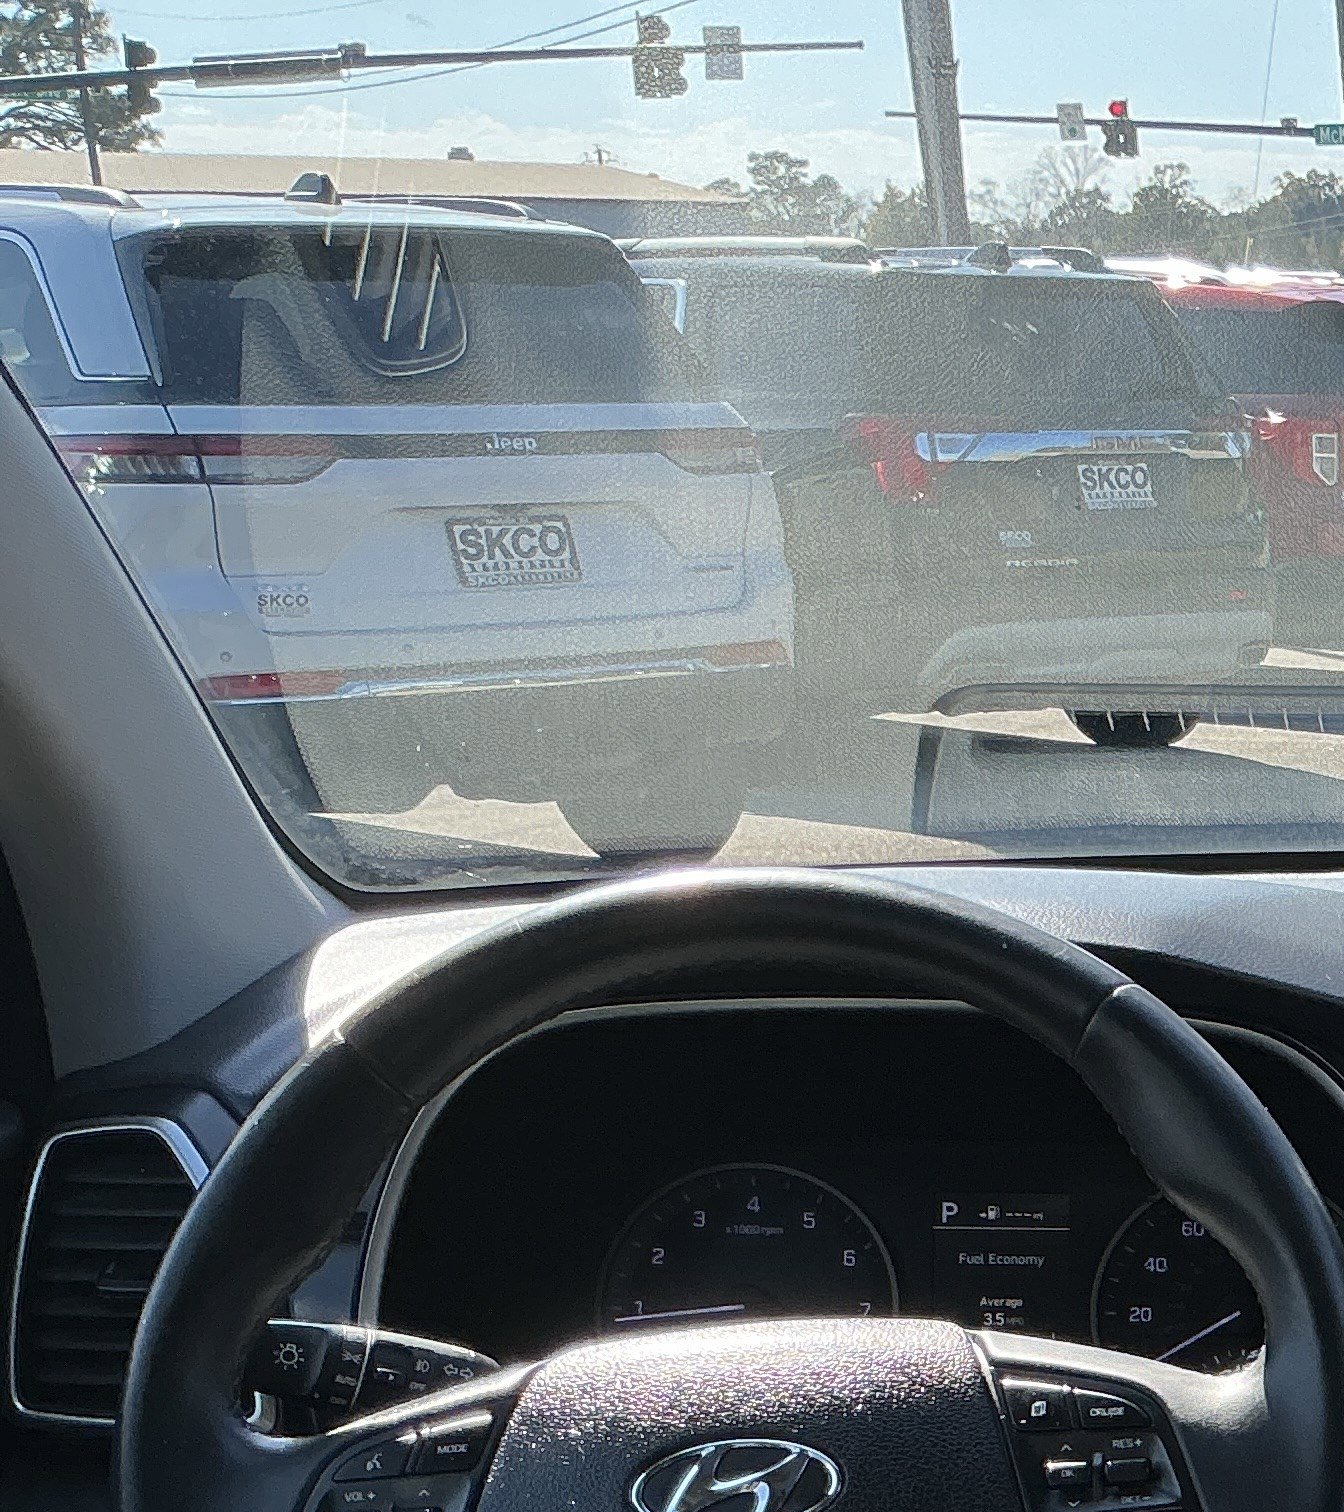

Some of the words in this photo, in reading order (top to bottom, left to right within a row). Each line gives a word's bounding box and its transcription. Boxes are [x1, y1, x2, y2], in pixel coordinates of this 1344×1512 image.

[486, 433, 538, 451] Jeep
[1081, 466, 1151, 492] SKCO
[459, 524, 568, 563] SKCO
[257, 593, 310, 608] SKCO
[747, 1196, 760, 1213] 4
[941, 1201, 958, 1224] P
[692, 1210, 706, 1228] 3
[803, 1212, 816, 1229] 5
[1181, 1221, 1205, 1237] 60
[651, 1247, 665, 1265] 2
[843, 1249, 856, 1267] 6
[958, 1252, 985, 1265] Fuel
[988, 1253, 1046, 1268] Economy
[1144, 1257, 1168, 1273] 40
[633, 1300, 644, 1315] 1
[860, 1302, 872, 1317] 7
[979, 1296, 1024, 1309] Average
[983, 1312, 1005, 1327] 3.5
[1129, 1306, 1153, 1323] 20
[1089, 1407, 1125, 1417] CRUISE
[437, 1443, 469, 1454] MODE
[1060, 1469, 1075, 1478] OK
